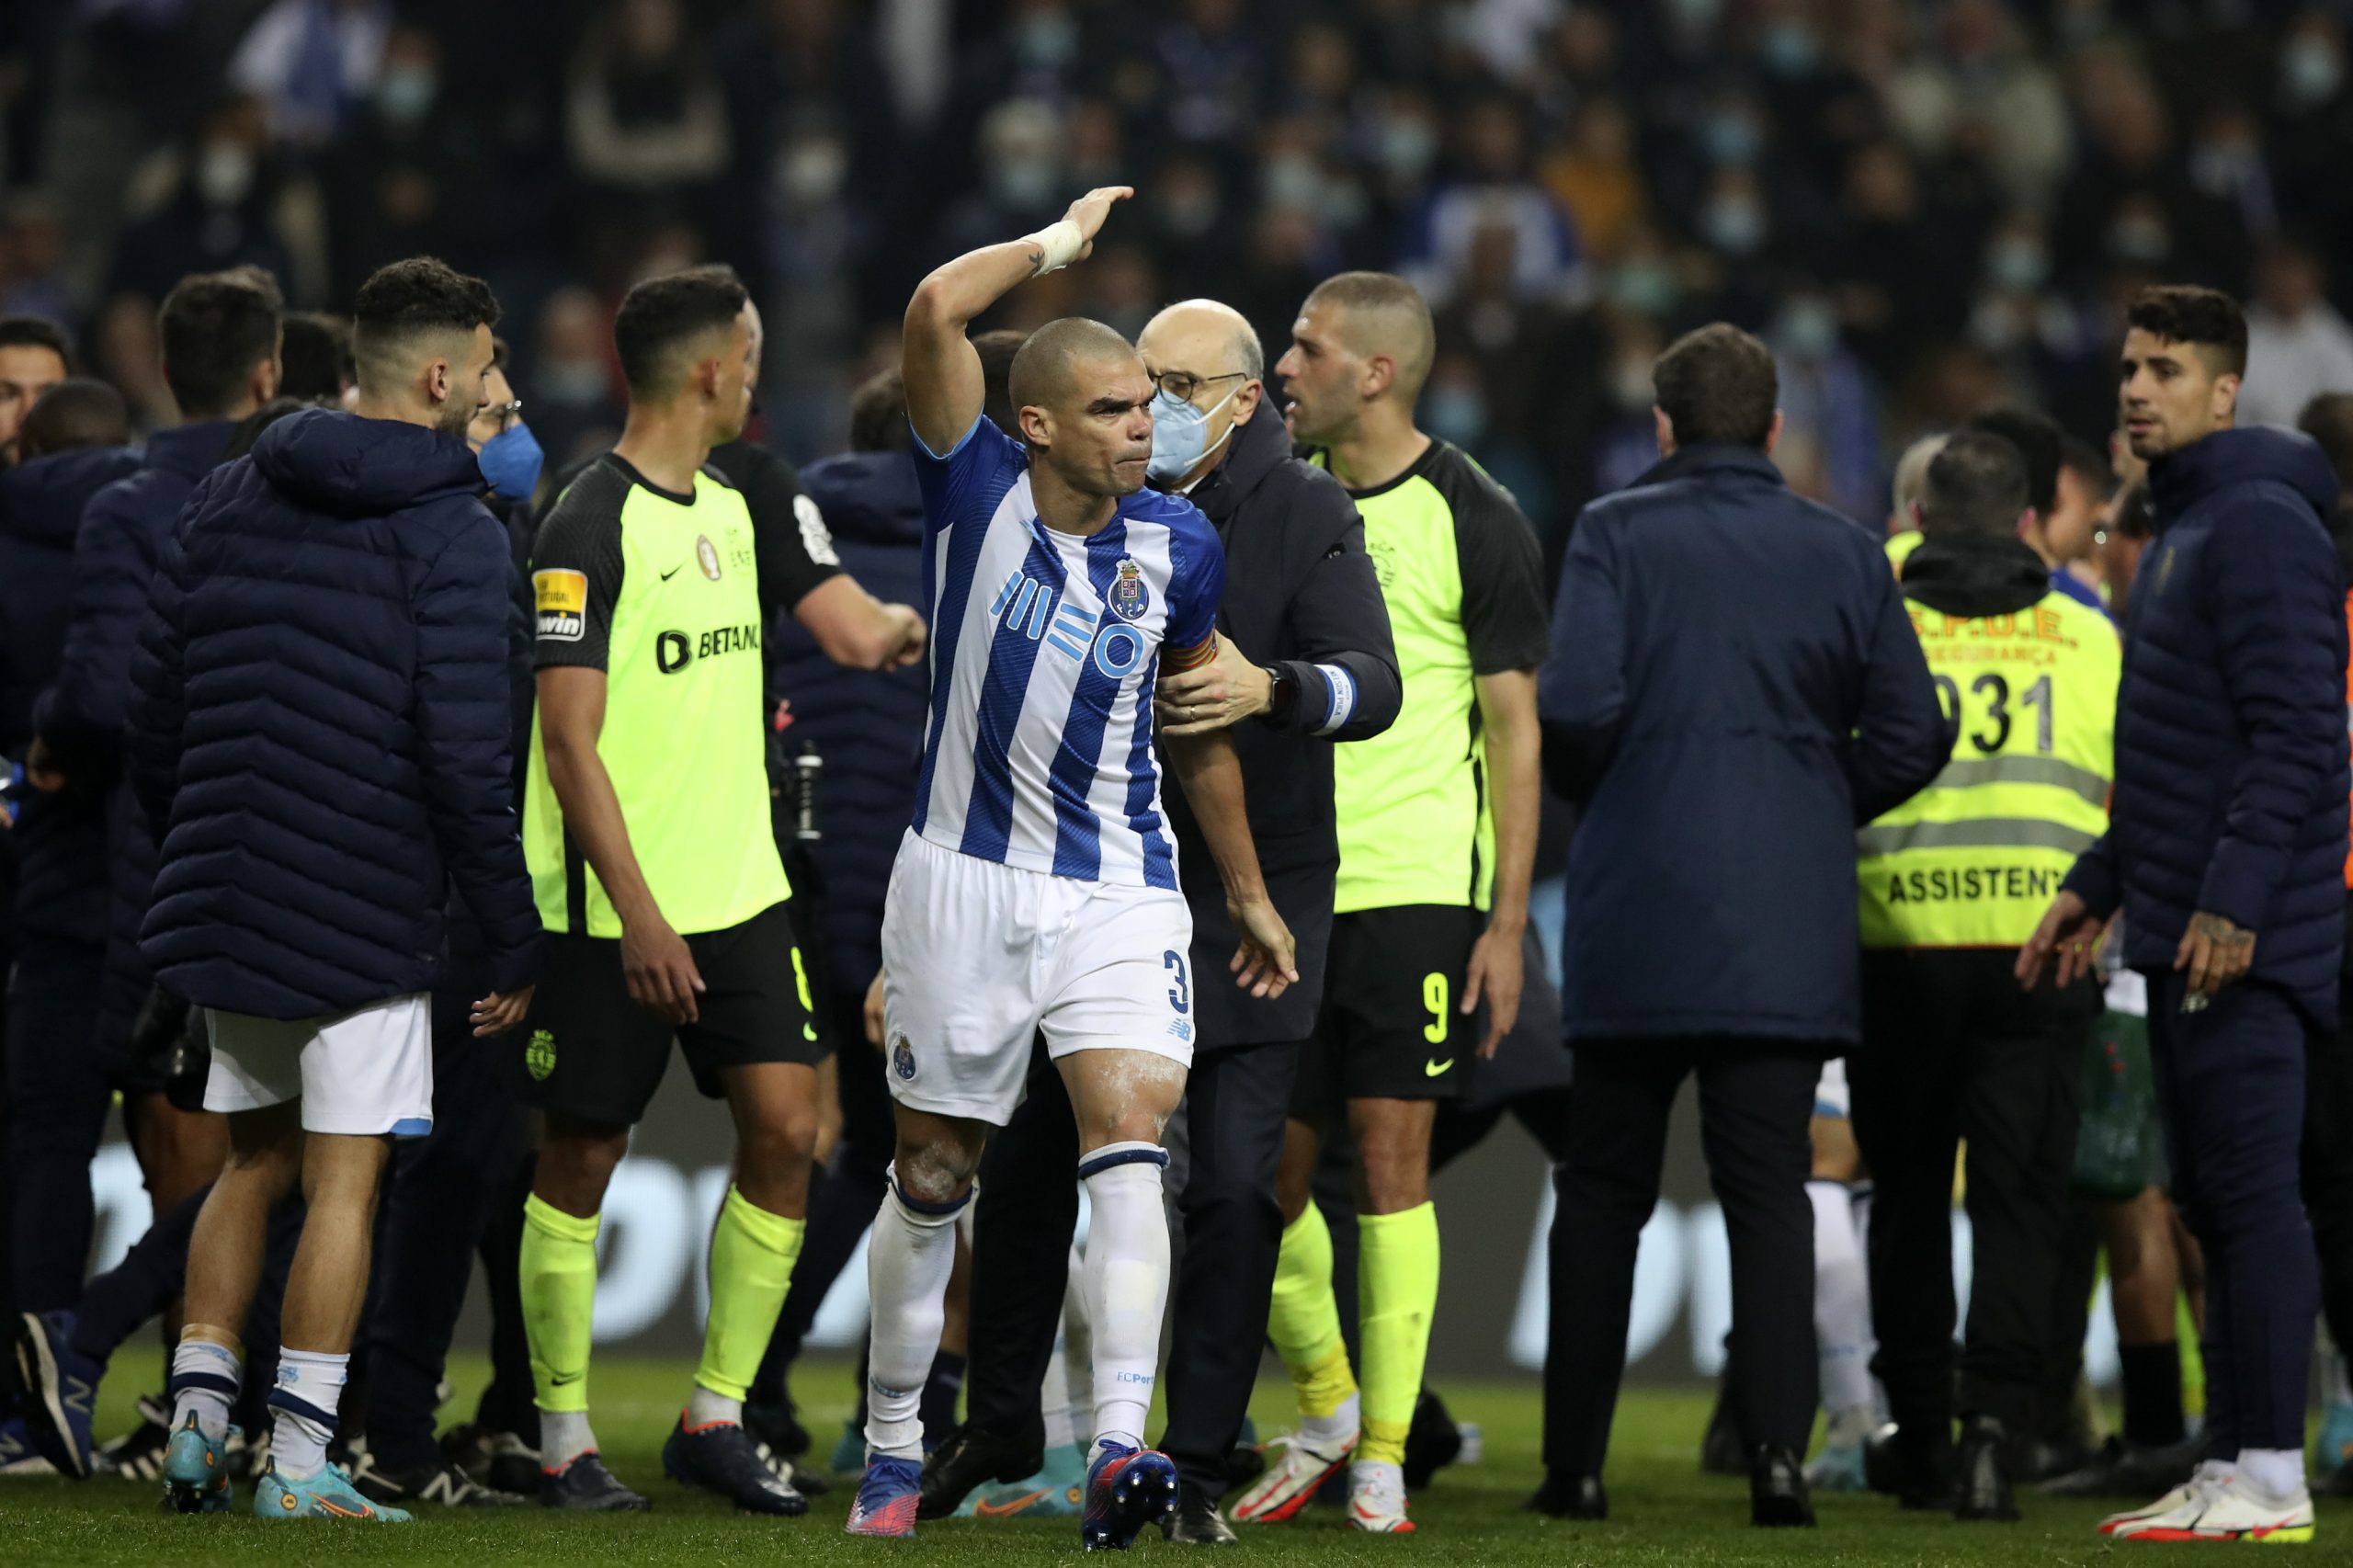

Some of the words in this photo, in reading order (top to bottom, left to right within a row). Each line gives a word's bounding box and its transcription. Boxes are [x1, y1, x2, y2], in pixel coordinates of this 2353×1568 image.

[699, 624, 759, 658] BETAN
[990, 569, 1144, 679] MEO
[1164, 949, 1188, 1015] 3
[1423, 971, 1449, 1044] 9
